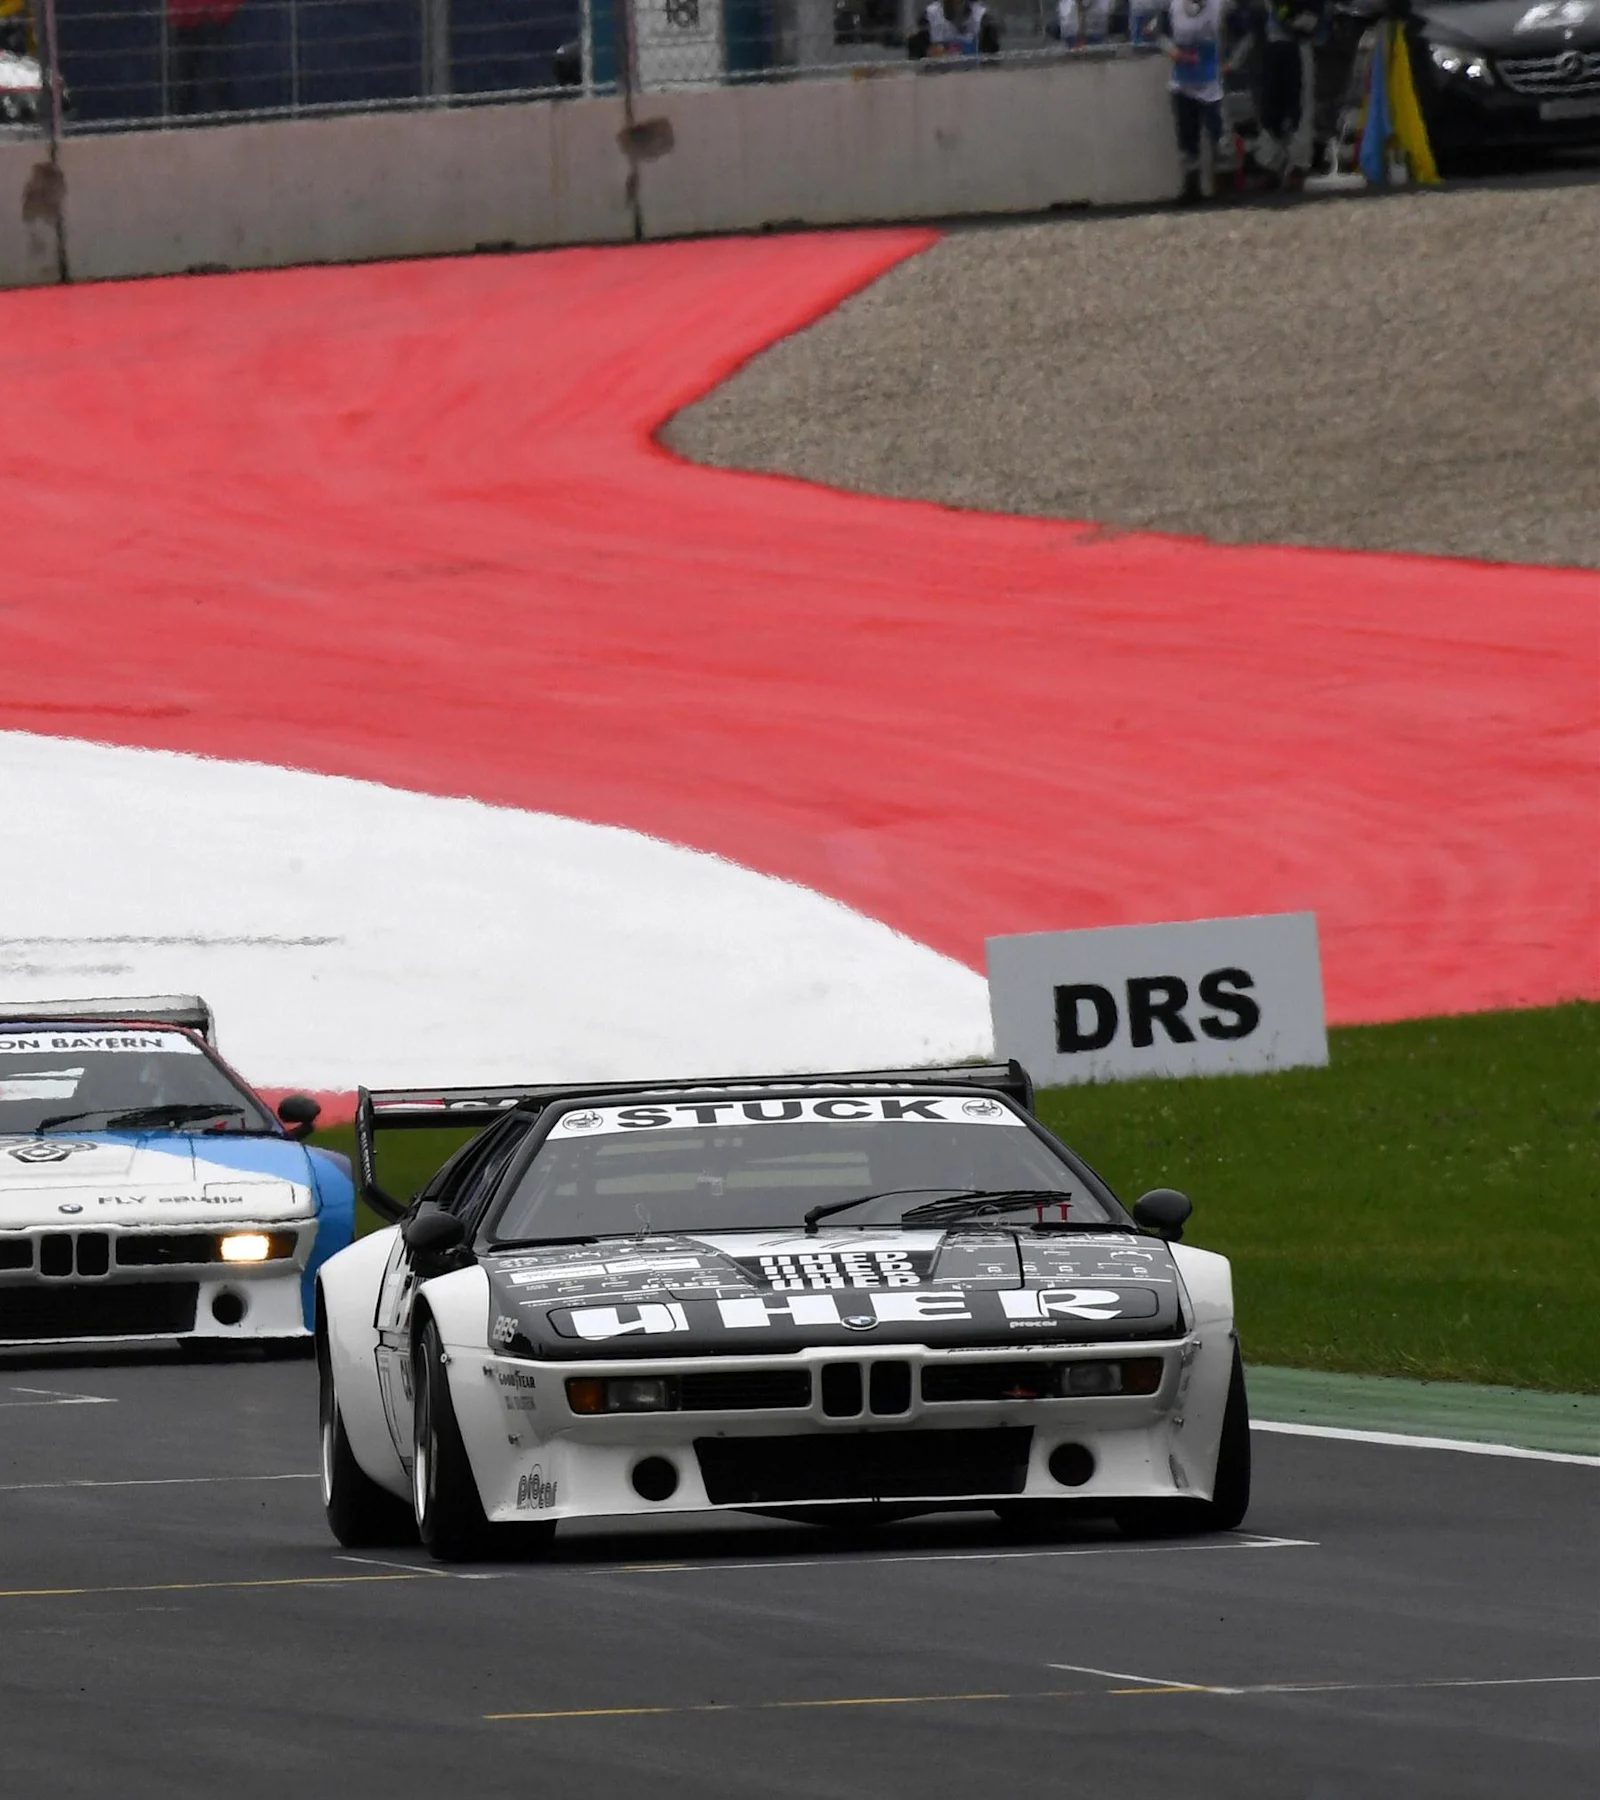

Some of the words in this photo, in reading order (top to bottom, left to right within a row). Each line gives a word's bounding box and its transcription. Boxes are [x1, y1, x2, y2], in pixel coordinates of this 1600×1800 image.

[1053, 967, 1261, 1053] DRS
[51, 1036, 164, 1049] BAYERN
[616, 1100, 949, 1128] STUCK
[492, 1315, 519, 1343] BBS
